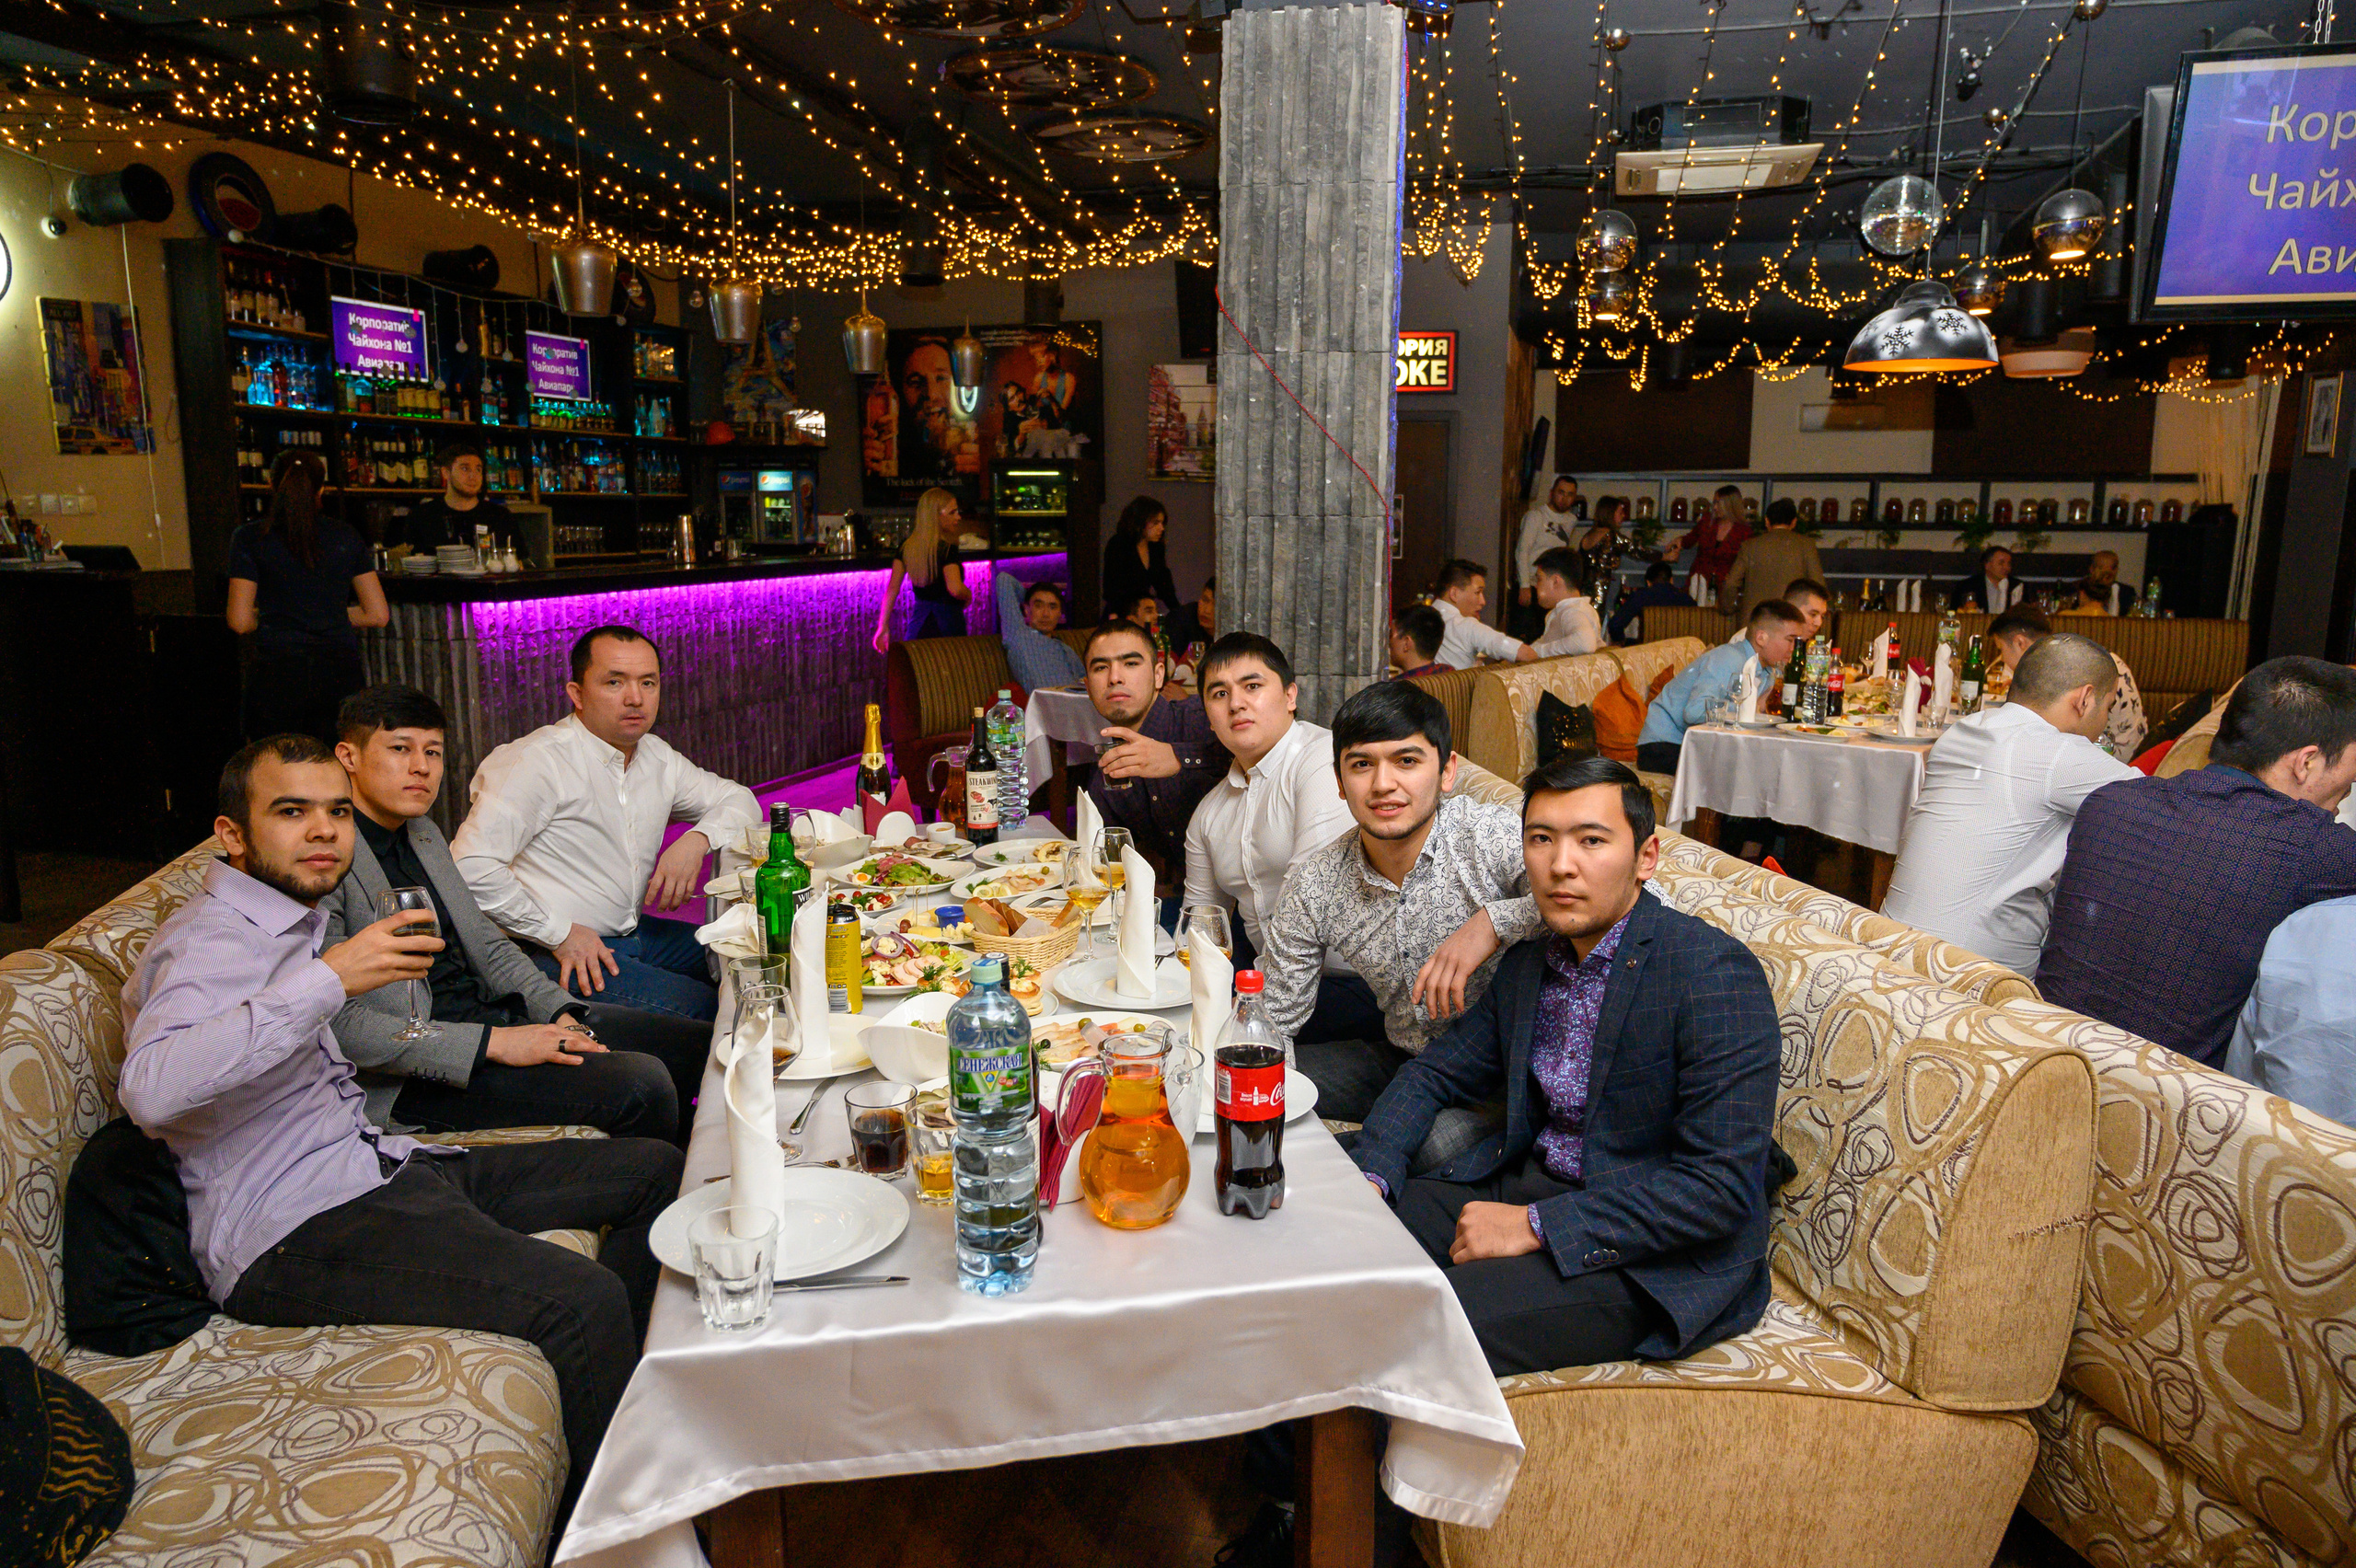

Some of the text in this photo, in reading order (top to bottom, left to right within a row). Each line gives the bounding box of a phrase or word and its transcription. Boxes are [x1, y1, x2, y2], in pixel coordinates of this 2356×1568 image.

[2267, 104, 2356, 150] Кор
[348, 332, 413, 353] Чайхона №1
[532, 342, 578, 360] Короратив
[532, 360, 580, 376] Чайхона №1
[958, 1052, 1022, 1073] СЕНЕЖСКАЯ
